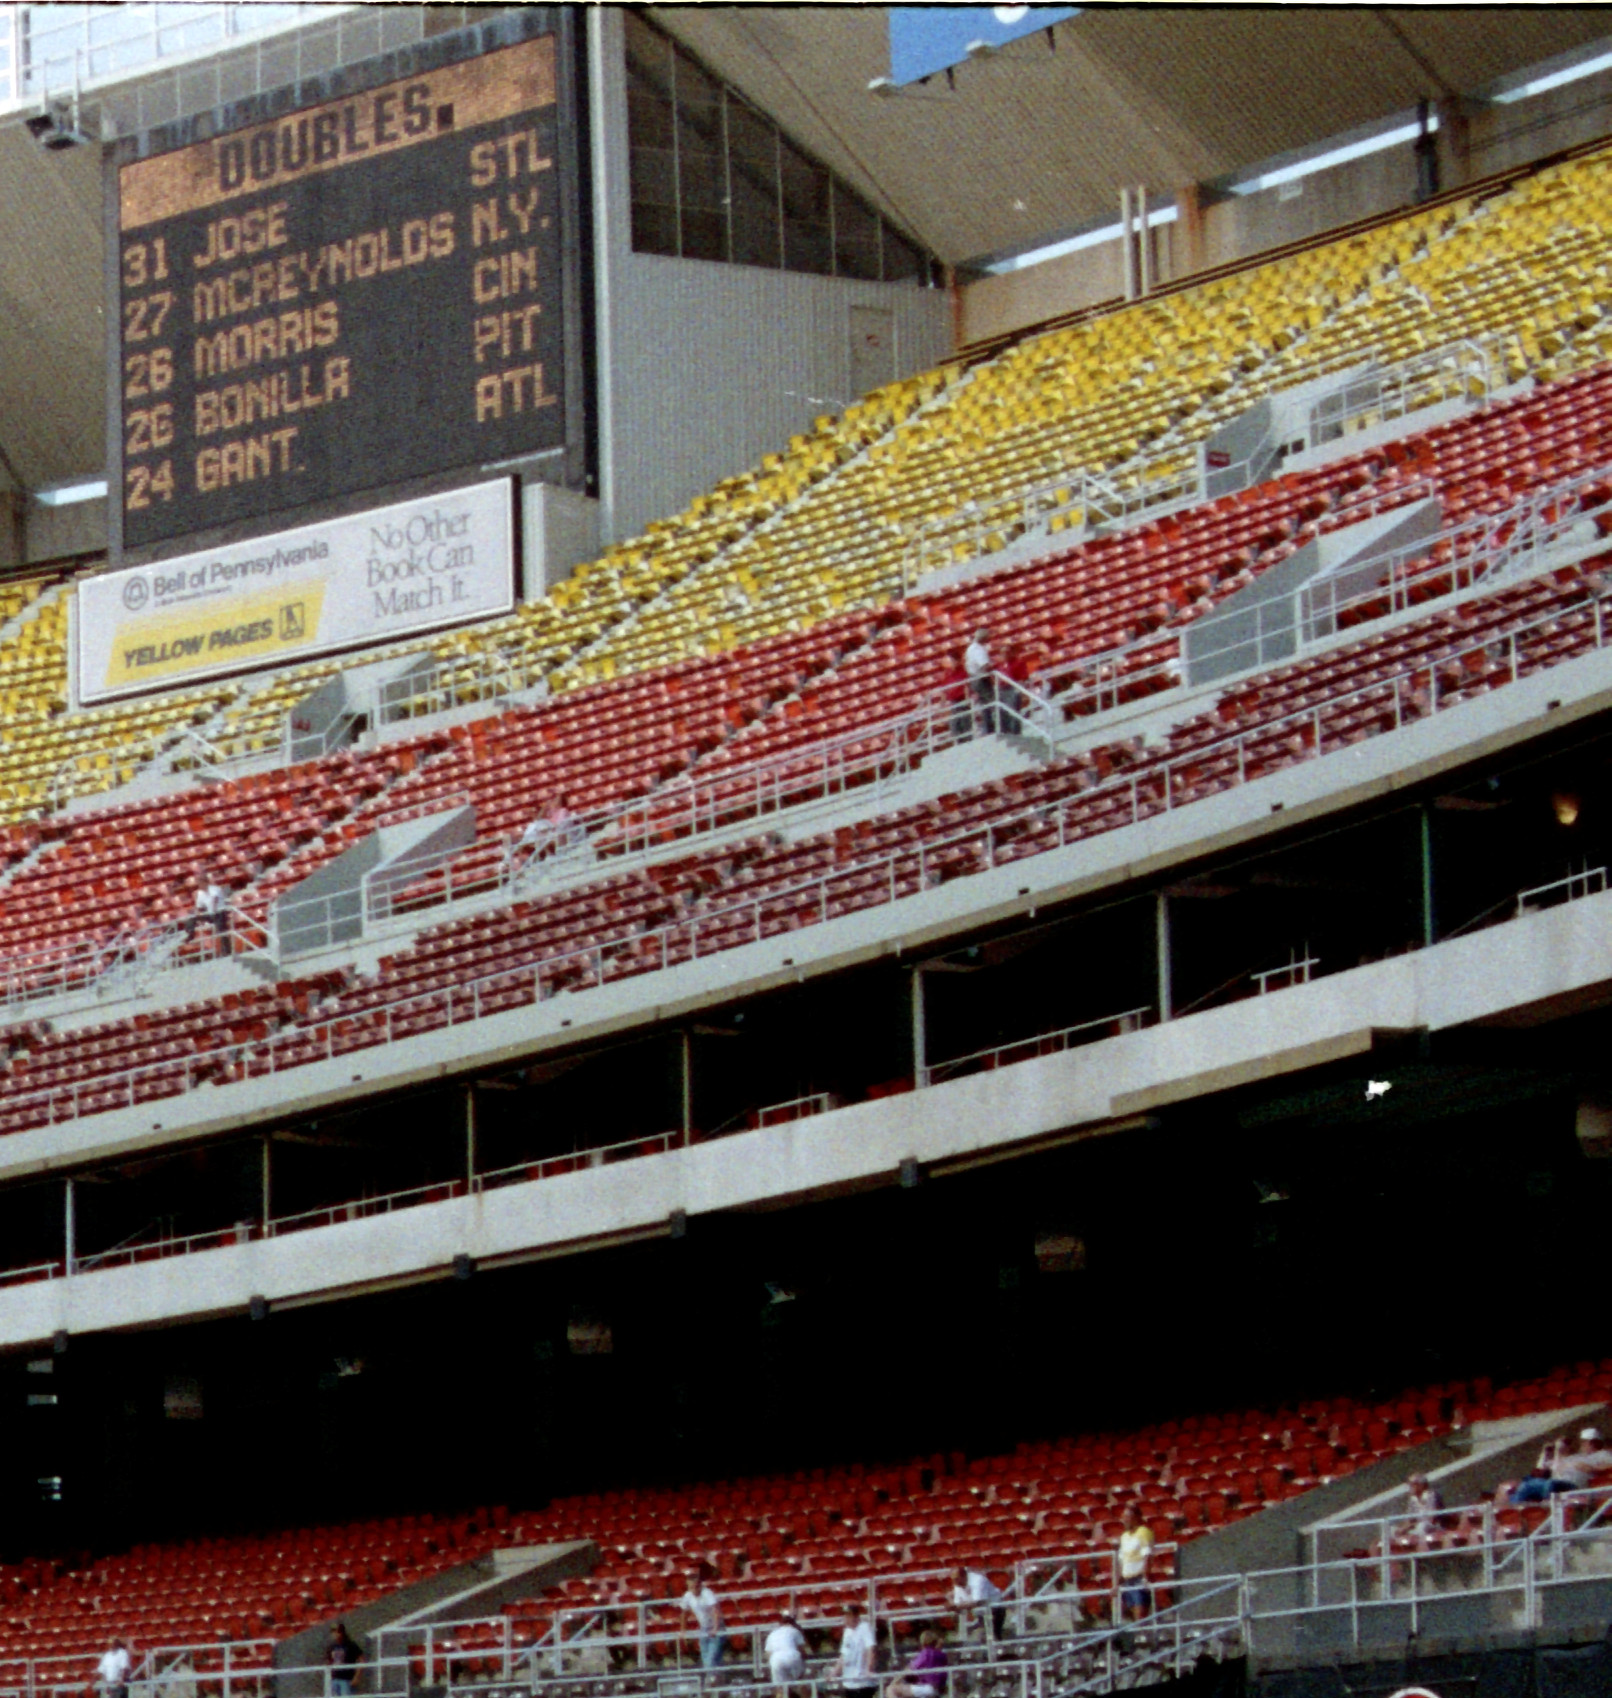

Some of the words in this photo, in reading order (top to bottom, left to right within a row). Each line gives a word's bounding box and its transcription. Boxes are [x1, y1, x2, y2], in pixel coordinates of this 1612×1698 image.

[123, 238, 170, 288] 31
[193, 202, 289, 268] JOSE
[470, 128, 551, 187] STL
[124, 292, 173, 343] 27
[193, 211, 455, 324] MCREYNOLDS
[471, 187, 550, 248] N.Y.
[124, 348, 173, 400] 26
[194, 301, 339, 379] MORRIS
[475, 247, 538, 304] CIN
[125, 403, 174, 456] 26
[194, 356, 351, 437] BONILLA
[475, 304, 542, 363] PIT
[126, 460, 174, 511] 24
[195, 428, 306, 493] GANT.
[477, 363, 558, 423] ATL
[153, 571, 186, 597] Bell
[189, 566, 207, 588] of
[210, 537, 330, 585] Pennsylvania
[366, 548, 427, 588] Book
[426, 542, 474, 573] Can
[370, 522, 404, 555] No
[406, 509, 471, 546] Other
[124, 633, 205, 669] YELLOW
[209, 618, 274, 650] PAGES
[374, 577, 444, 619] Match
